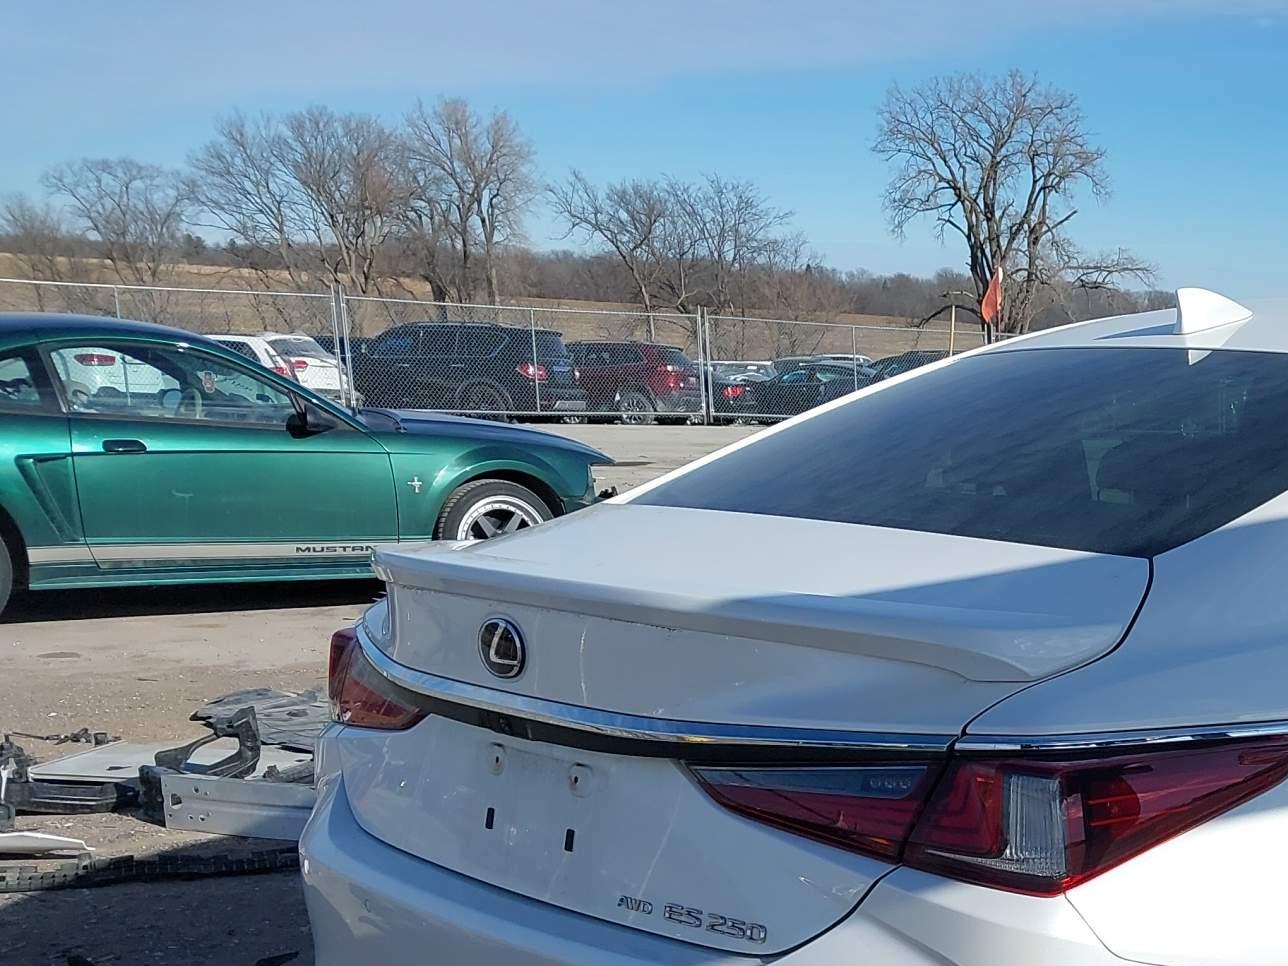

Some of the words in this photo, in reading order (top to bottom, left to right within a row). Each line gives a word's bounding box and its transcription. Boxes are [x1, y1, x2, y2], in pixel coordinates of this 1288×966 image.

[617, 895, 654, 915] AWD
[663, 902, 703, 928] ES
[705, 912, 768, 945] 250
